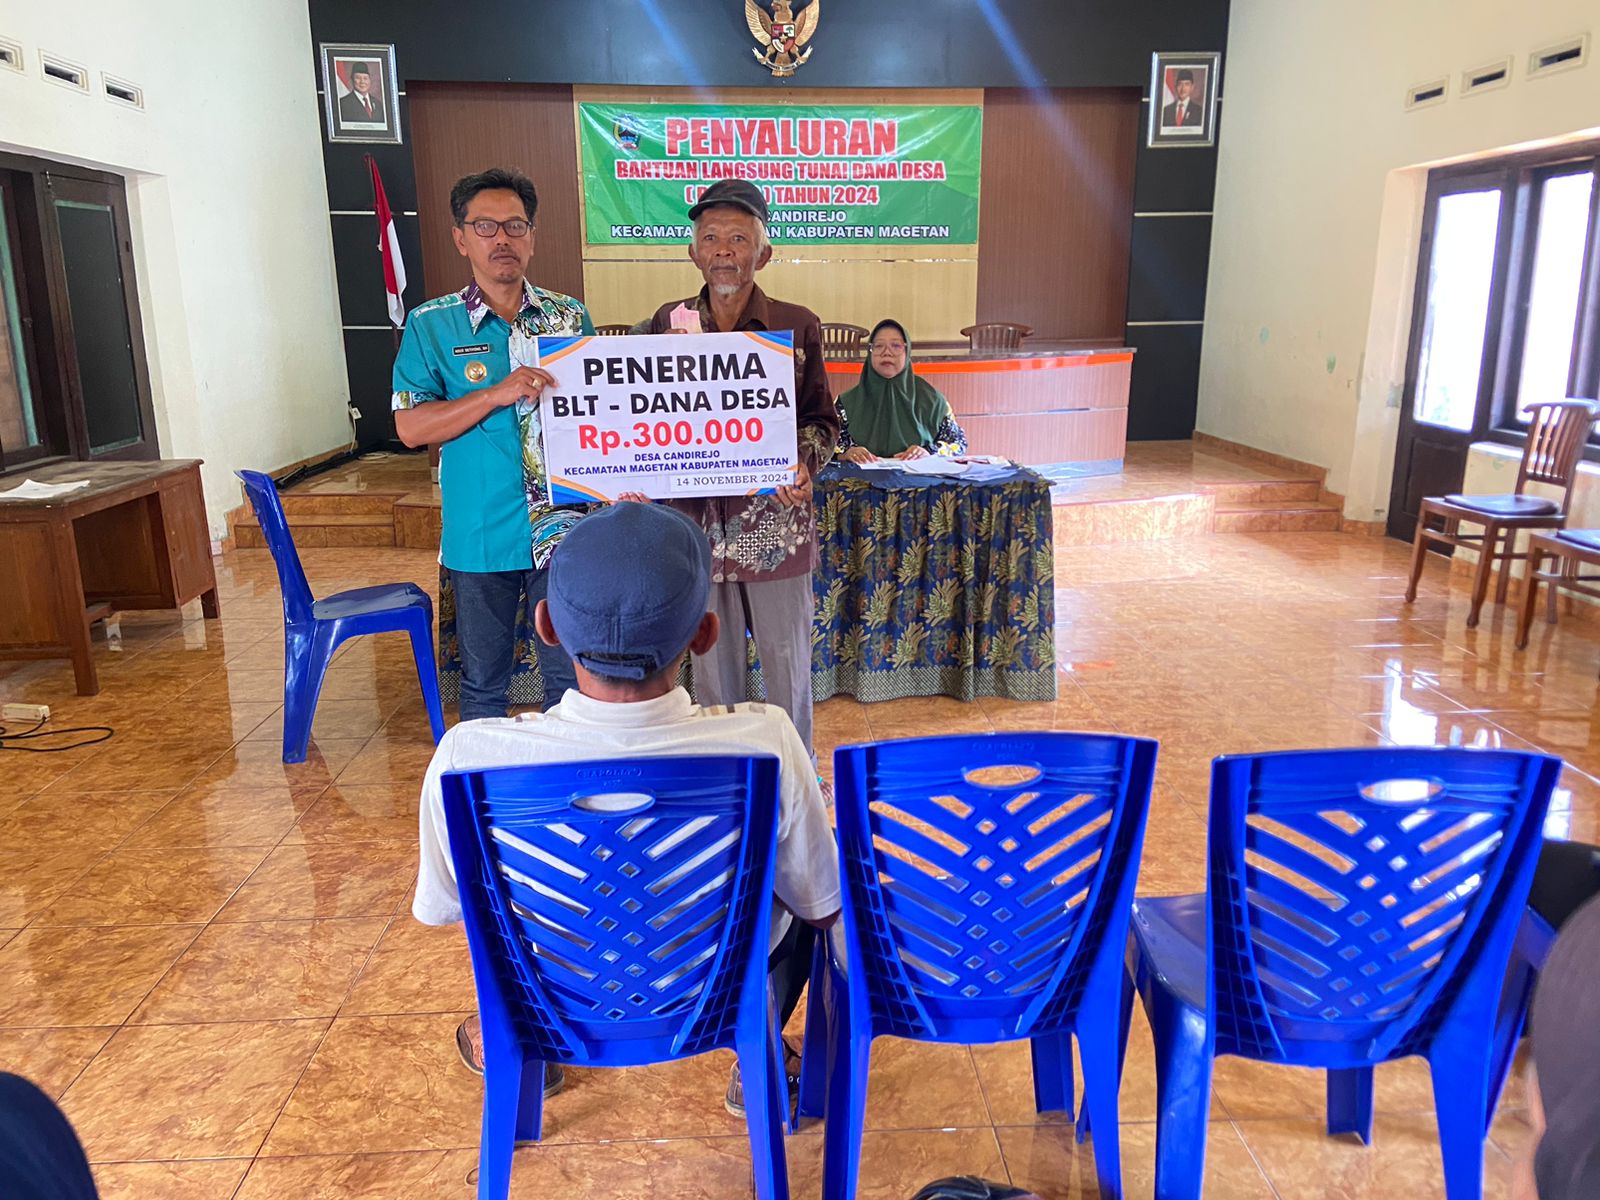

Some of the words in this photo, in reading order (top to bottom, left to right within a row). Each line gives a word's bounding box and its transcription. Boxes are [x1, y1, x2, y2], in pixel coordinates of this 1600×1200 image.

[666, 117, 897, 156] PENYALURAN
[616, 160, 698, 179] BANTUAN
[702, 161, 793, 180] LANGSUNG
[797, 161, 848, 180] TUNAI
[852, 161, 898, 180] DANA
[902, 161, 945, 180] DESA
[773, 186, 831, 204] TAHUN
[833, 186, 880, 204] 2024
[611, 226, 692, 238] KECAMATA
[786, 226, 874, 238] KABUPATEN
[878, 226, 949, 238] MAGETAN
[583, 352, 767, 385] PENERIMA
[552, 395, 599, 417] BLT
[630, 391, 712, 414] DANA
[721, 387, 790, 411] DESA
[578, 417, 763, 455] Rp.300.000
[634, 453, 662, 462] DESA
[663, 450, 720, 461] CANDIREJO
[564, 466, 627, 476] KECAMATAN
[629, 463, 678, 473] MAGETAN
[681, 460, 740, 471] KABUPATEN
[742, 457, 789, 467] MAGETAN
[676, 478, 689, 486] 14
[693, 475, 758, 486] NOVEMBER
[761, 474, 788, 483] 2024
